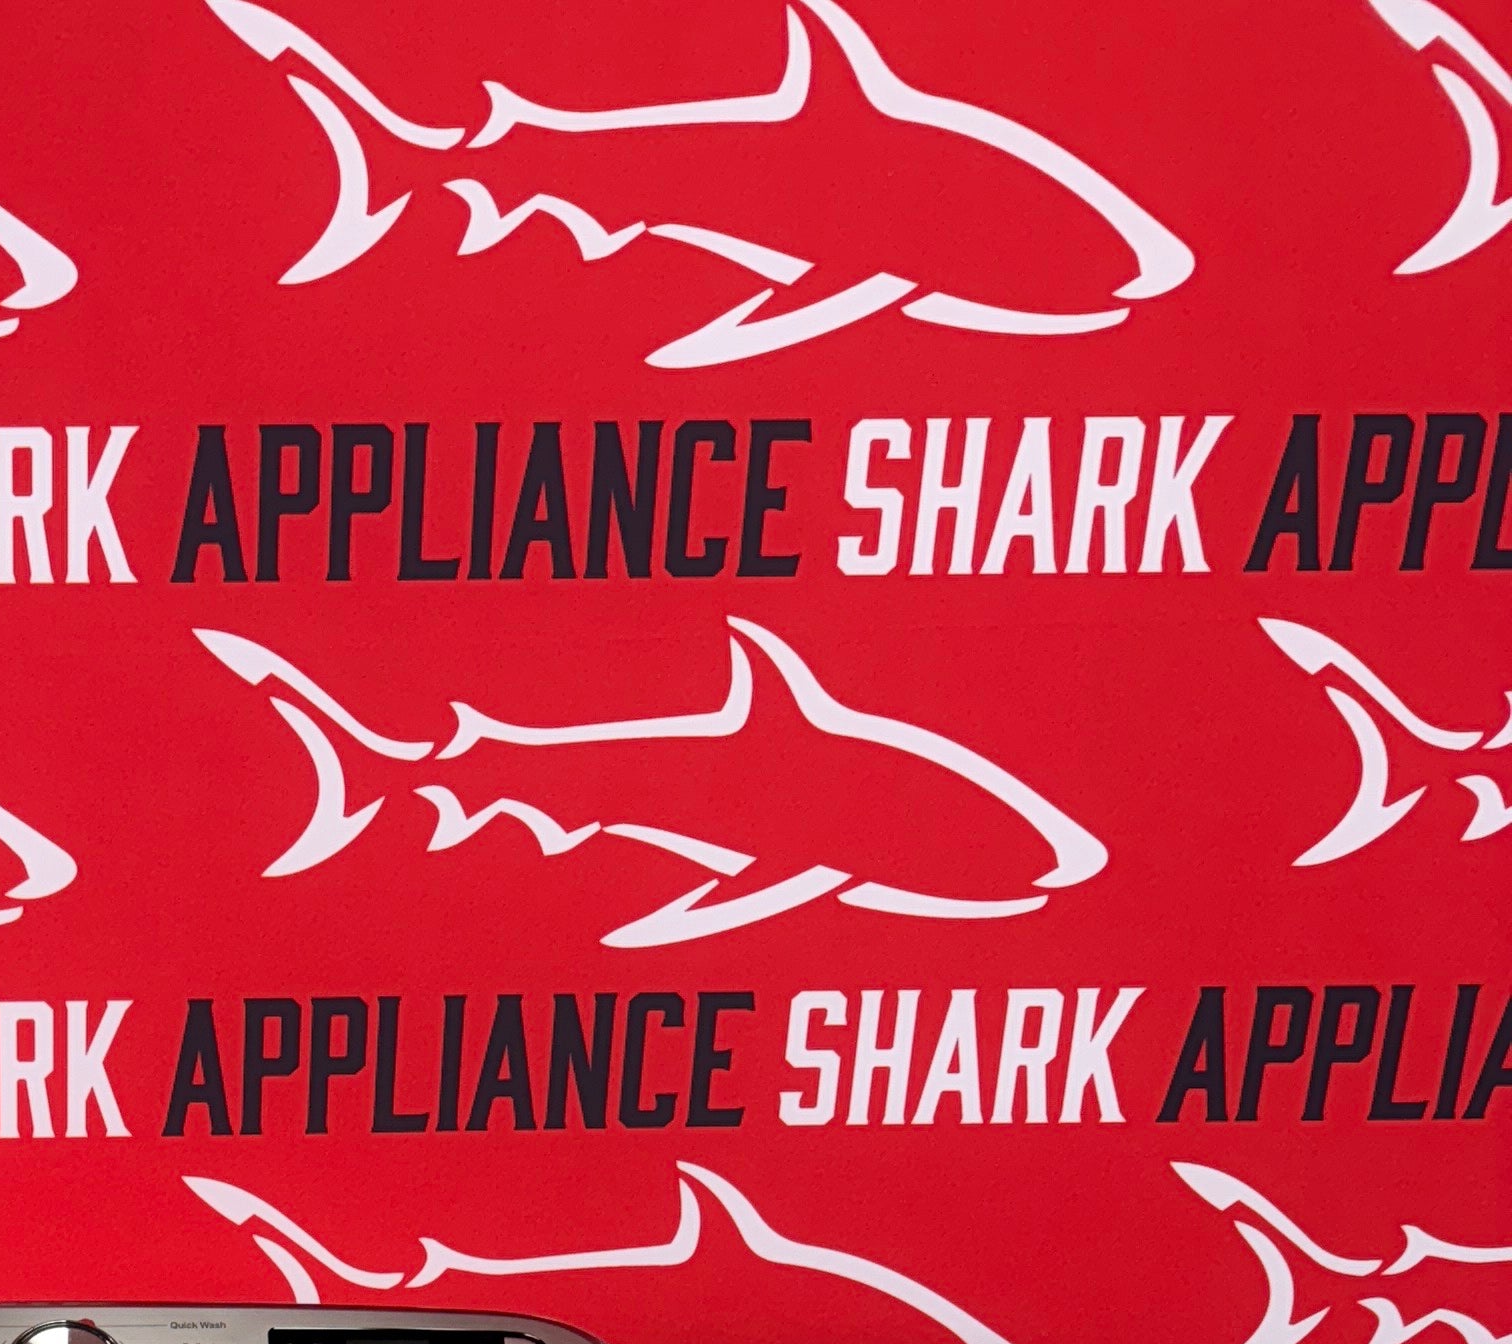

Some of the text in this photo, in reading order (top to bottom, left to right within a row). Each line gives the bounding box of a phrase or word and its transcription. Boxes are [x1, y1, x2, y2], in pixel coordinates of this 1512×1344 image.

[171, 420, 811, 583] APPLIANCE
[836, 415, 1235, 576] SHARK
[163, 992, 754, 1137] APPLIANCE
[778, 987, 1147, 1127] SHARK
[170, 1321, 226, 1329] Quick Wash
